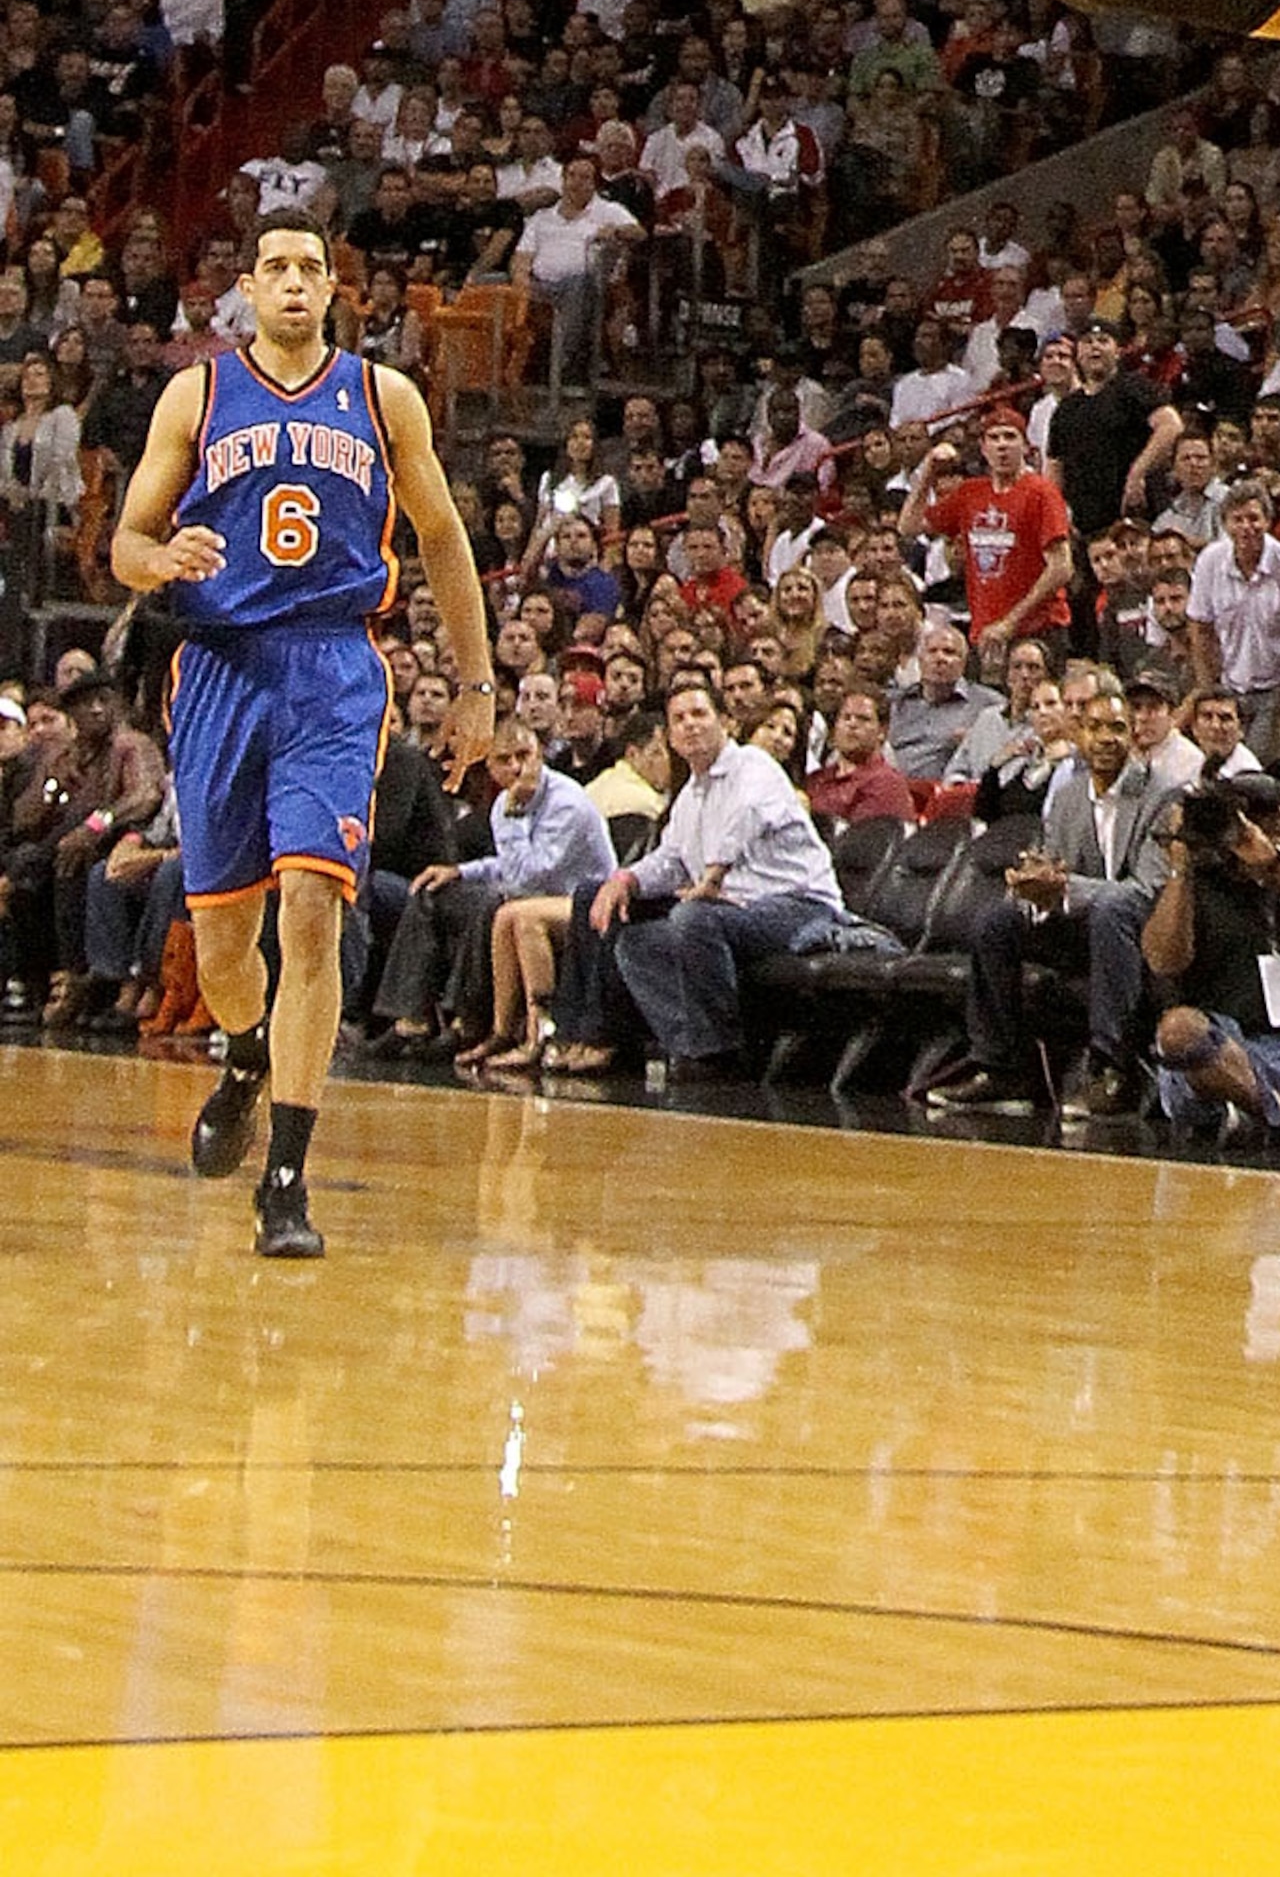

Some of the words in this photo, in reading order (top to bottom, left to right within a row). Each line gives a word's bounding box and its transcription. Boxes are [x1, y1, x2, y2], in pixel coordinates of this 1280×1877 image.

[205, 422, 280, 495] NEW
[286, 419, 373, 497] YORK
[260, 483, 321, 567] 6
